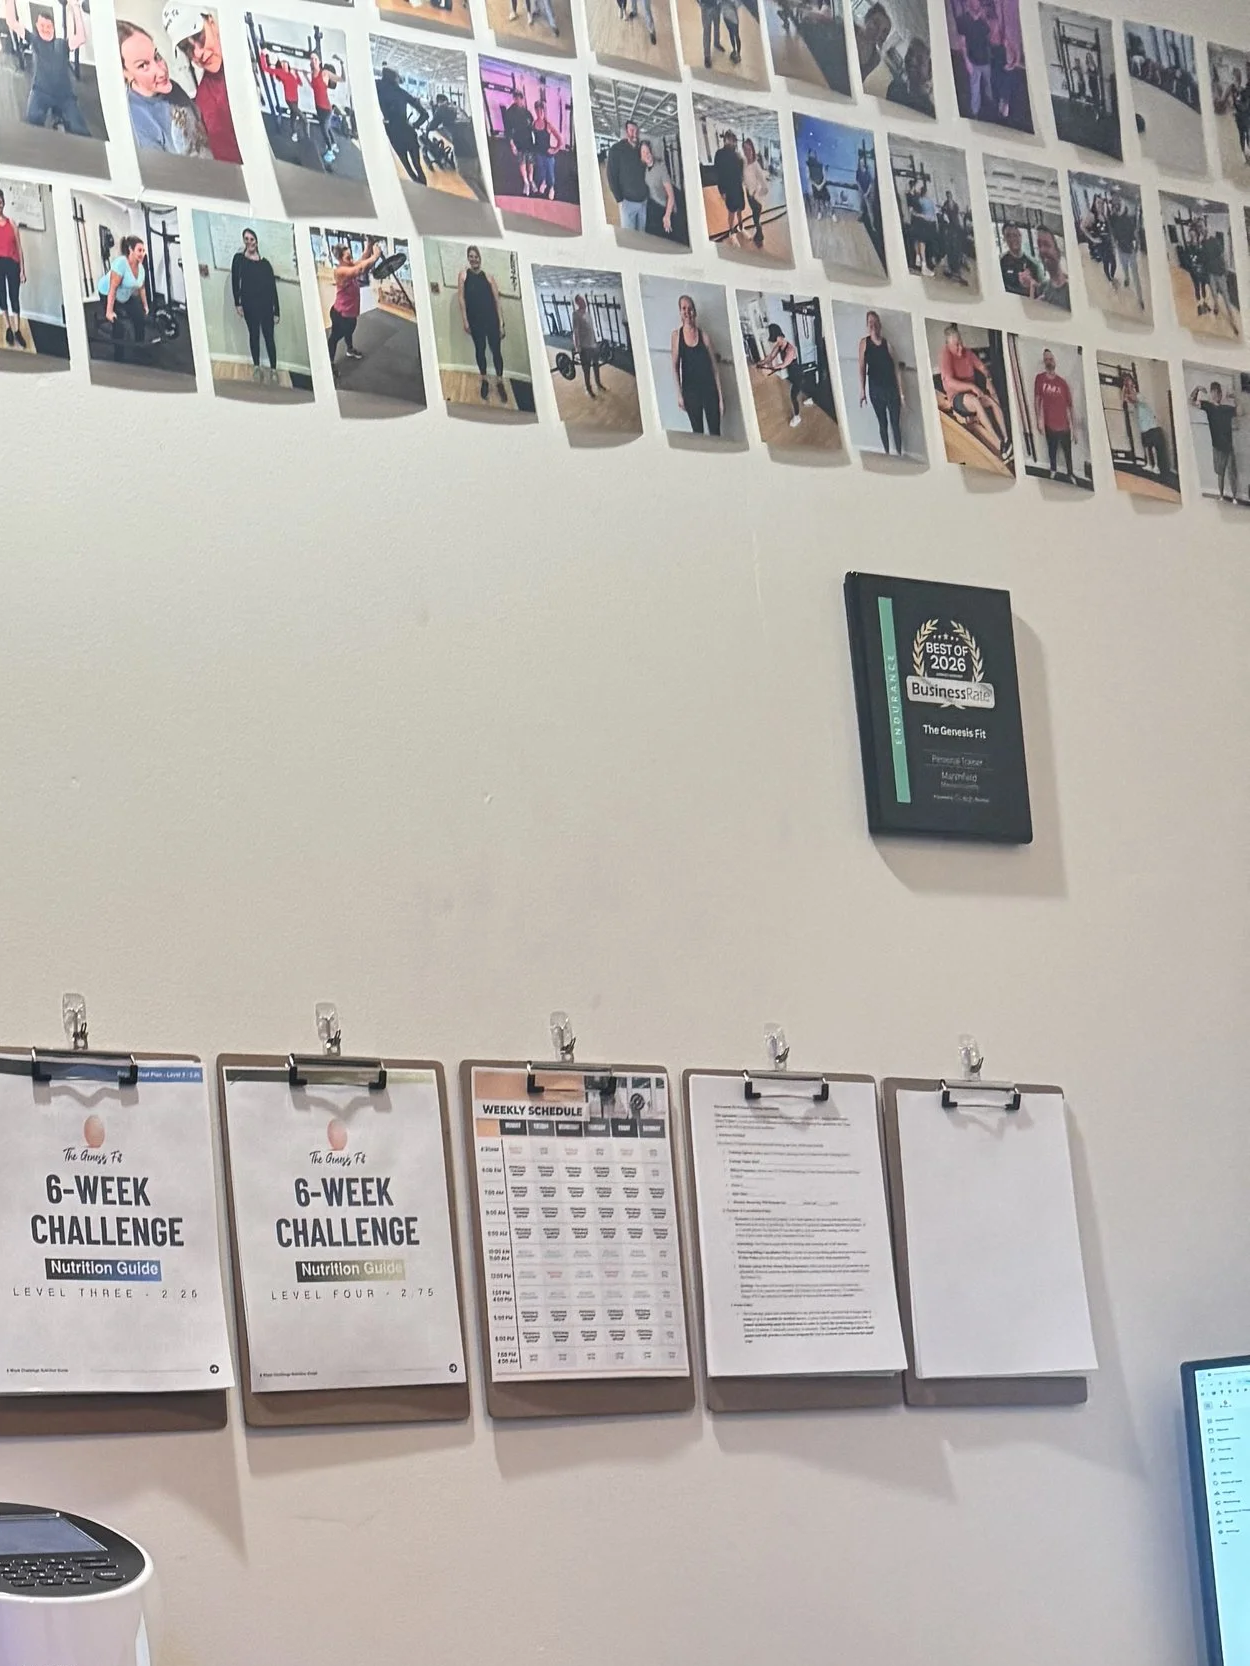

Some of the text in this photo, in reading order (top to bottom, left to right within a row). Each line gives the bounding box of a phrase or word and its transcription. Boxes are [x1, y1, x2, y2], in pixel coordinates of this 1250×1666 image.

[926, 642, 969, 656] BEST OF
[931, 655, 967, 672] 2026
[887, 655, 903, 745] ENDURANCE
[923, 724, 987, 739] The Genesis Fit
[483, 1104, 583, 1117] WEEKLY SCHEDULE
[62, 1148, 78, 1162] The
[309, 1151, 323, 1164] The
[46, 1174, 151, 1207] 6-WEEK
[294, 1177, 394, 1207] 6-WEEK
[31, 1214, 184, 1247] CHALLENGE
[276, 1216, 420, 1247] CHALLENGE
[51, 1260, 158, 1275] Nutrition Guide
[301, 1260, 403, 1276] Nutrition Guide
[13, 1287, 65, 1297] LEVEL
[79, 1288, 132, 1298] THREE
[271, 1291, 321, 1300] LEVEL
[333, 1289, 375, 1299] FOUR
